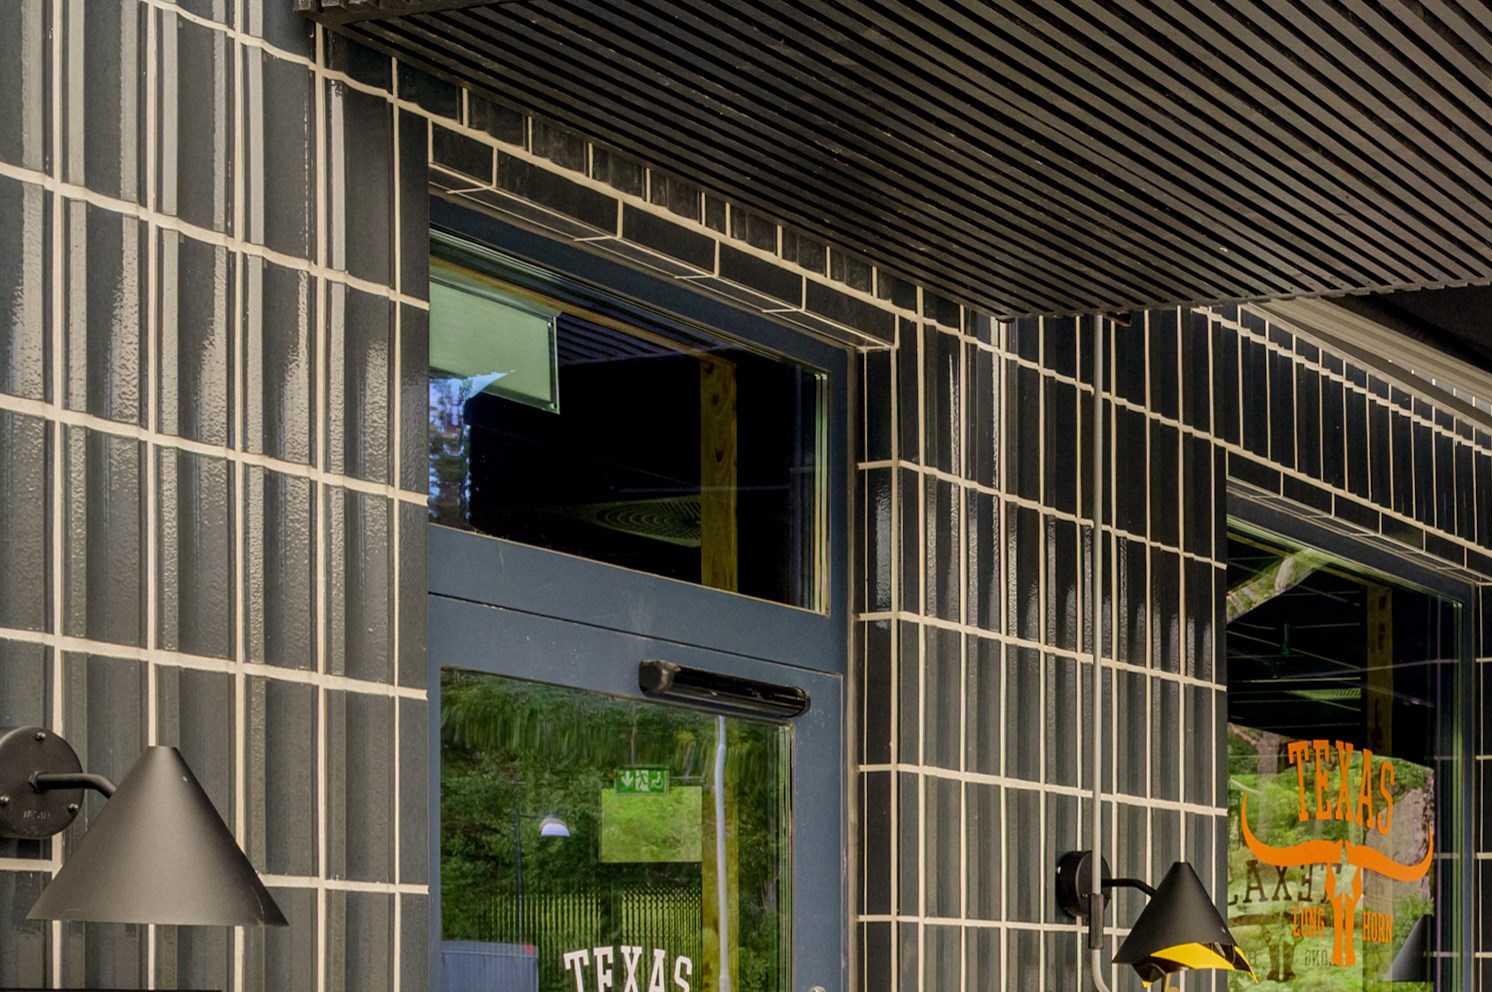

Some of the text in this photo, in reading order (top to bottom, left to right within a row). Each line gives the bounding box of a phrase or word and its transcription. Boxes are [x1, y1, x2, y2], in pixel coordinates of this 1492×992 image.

[1288, 739, 1395, 836] TEXAS
[1292, 904, 1325, 938] LONG
[1362, 911, 1393, 943] HORN
